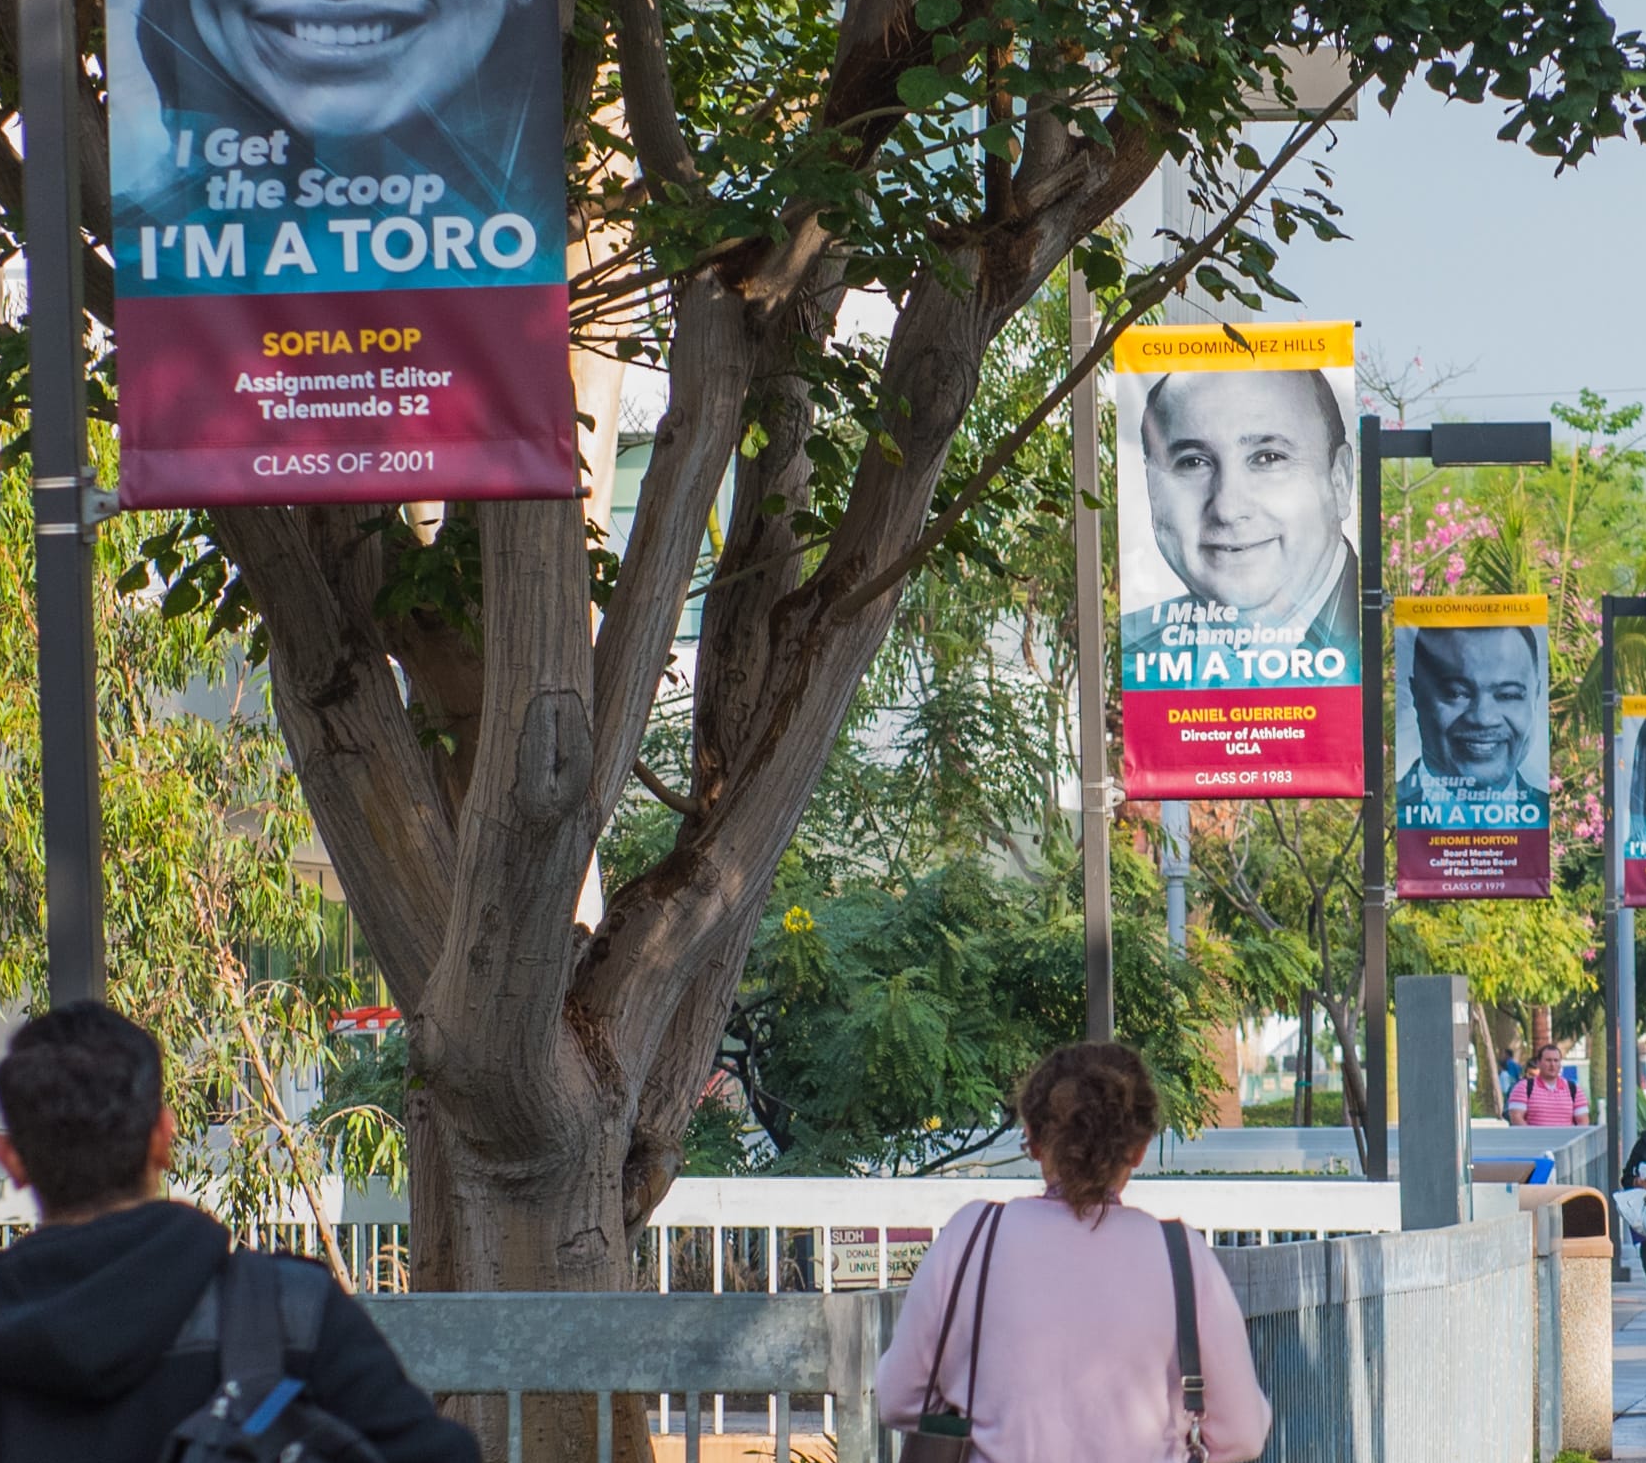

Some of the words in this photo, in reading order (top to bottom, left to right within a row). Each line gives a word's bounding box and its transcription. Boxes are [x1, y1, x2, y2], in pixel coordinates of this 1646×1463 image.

[176, 129, 194, 167] I
[204, 128, 290, 167] Get
[206, 169, 286, 211] the
[294, 168, 445, 216] Scoop
[140, 223, 246, 281] I'M
[263, 221, 318, 276] A
[328, 212, 537, 273] TORO
[262, 330, 353, 357] SOFIA
[360, 328, 422, 352] POP
[1142, 342, 1173, 356] CSU
[1179, 339, 1278, 355] DOMINGUEZ
[1284, 337, 1326, 352] HILLS
[234, 369, 375, 397] Assignment
[380, 366, 452, 388] Editor
[258, 396, 393, 420] Telemundo
[398, 394, 430, 416] 52
[253, 453, 330, 476] CLASS
[337, 452, 373, 474] OF
[378, 451, 434, 472] 2001
[1152, 603, 1162, 624] I
[1166, 601, 1238, 624] Make
[1412, 604, 1433, 614] CSU
[1435, 603, 1500, 614] DOMINGUEZ
[1161, 623, 1306, 650] Champions
[1135, 651, 1193, 682] I'M
[1201, 651, 1231, 681] A
[1237, 647, 1346, 680] TORO
[1168, 708, 1227, 724] DANIEL
[1229, 706, 1317, 722] GUERRERO
[1180, 728, 1232, 742] Director
[1234, 727, 1249, 741] of
[1250, 726, 1306, 740] Athletics
[1225, 742, 1262, 755] UCLA
[1195, 772, 1237, 785] CLASS
[1239, 771, 1259, 784] OF
[1262, 770, 1293, 783] 1983
[1456, 787, 1528, 802] Business
[1405, 804, 1442, 825] I'M
[1447, 804, 1467, 825] A
[1469, 803, 1541, 825] TORO
[1428, 836, 1471, 846] JEROME
[1473, 835, 1518, 846] HORTON
[831, 1230, 865, 1244] SUDH
